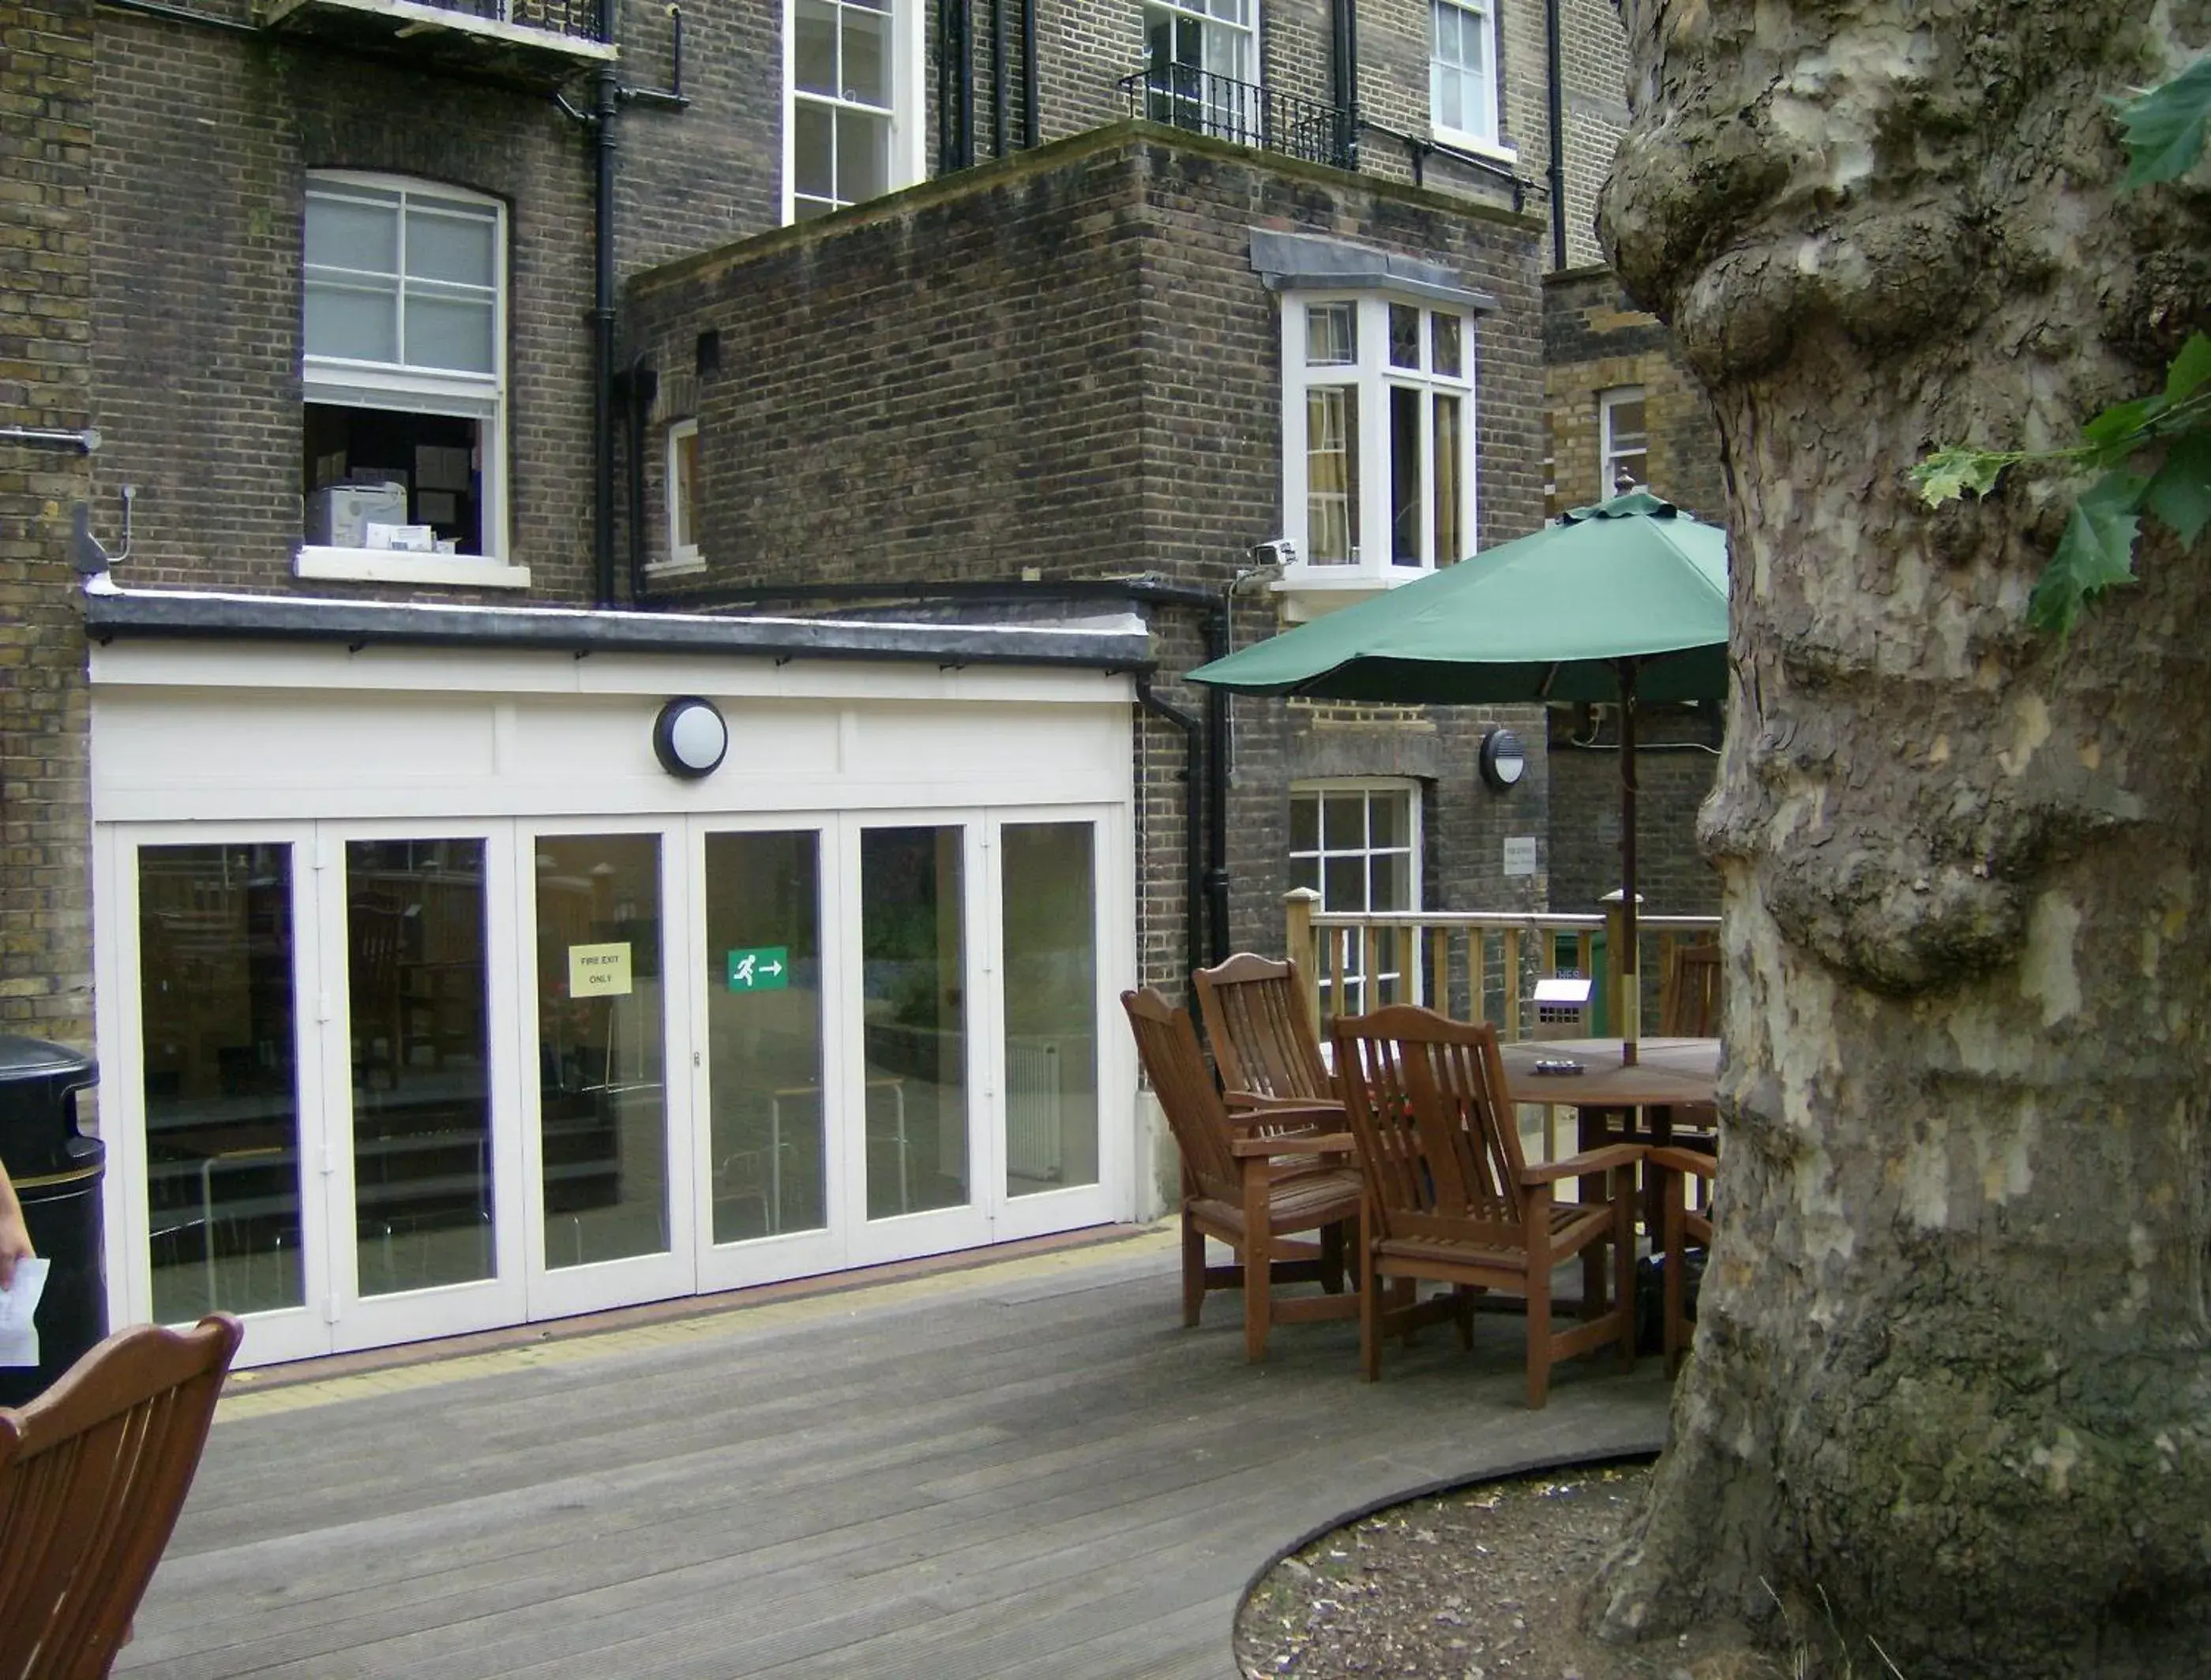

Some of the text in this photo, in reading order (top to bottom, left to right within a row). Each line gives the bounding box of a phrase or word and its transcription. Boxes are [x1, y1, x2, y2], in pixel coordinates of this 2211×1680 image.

[580, 955, 619, 966] FIRE EXIT
[589, 974, 612, 984] ONLY
